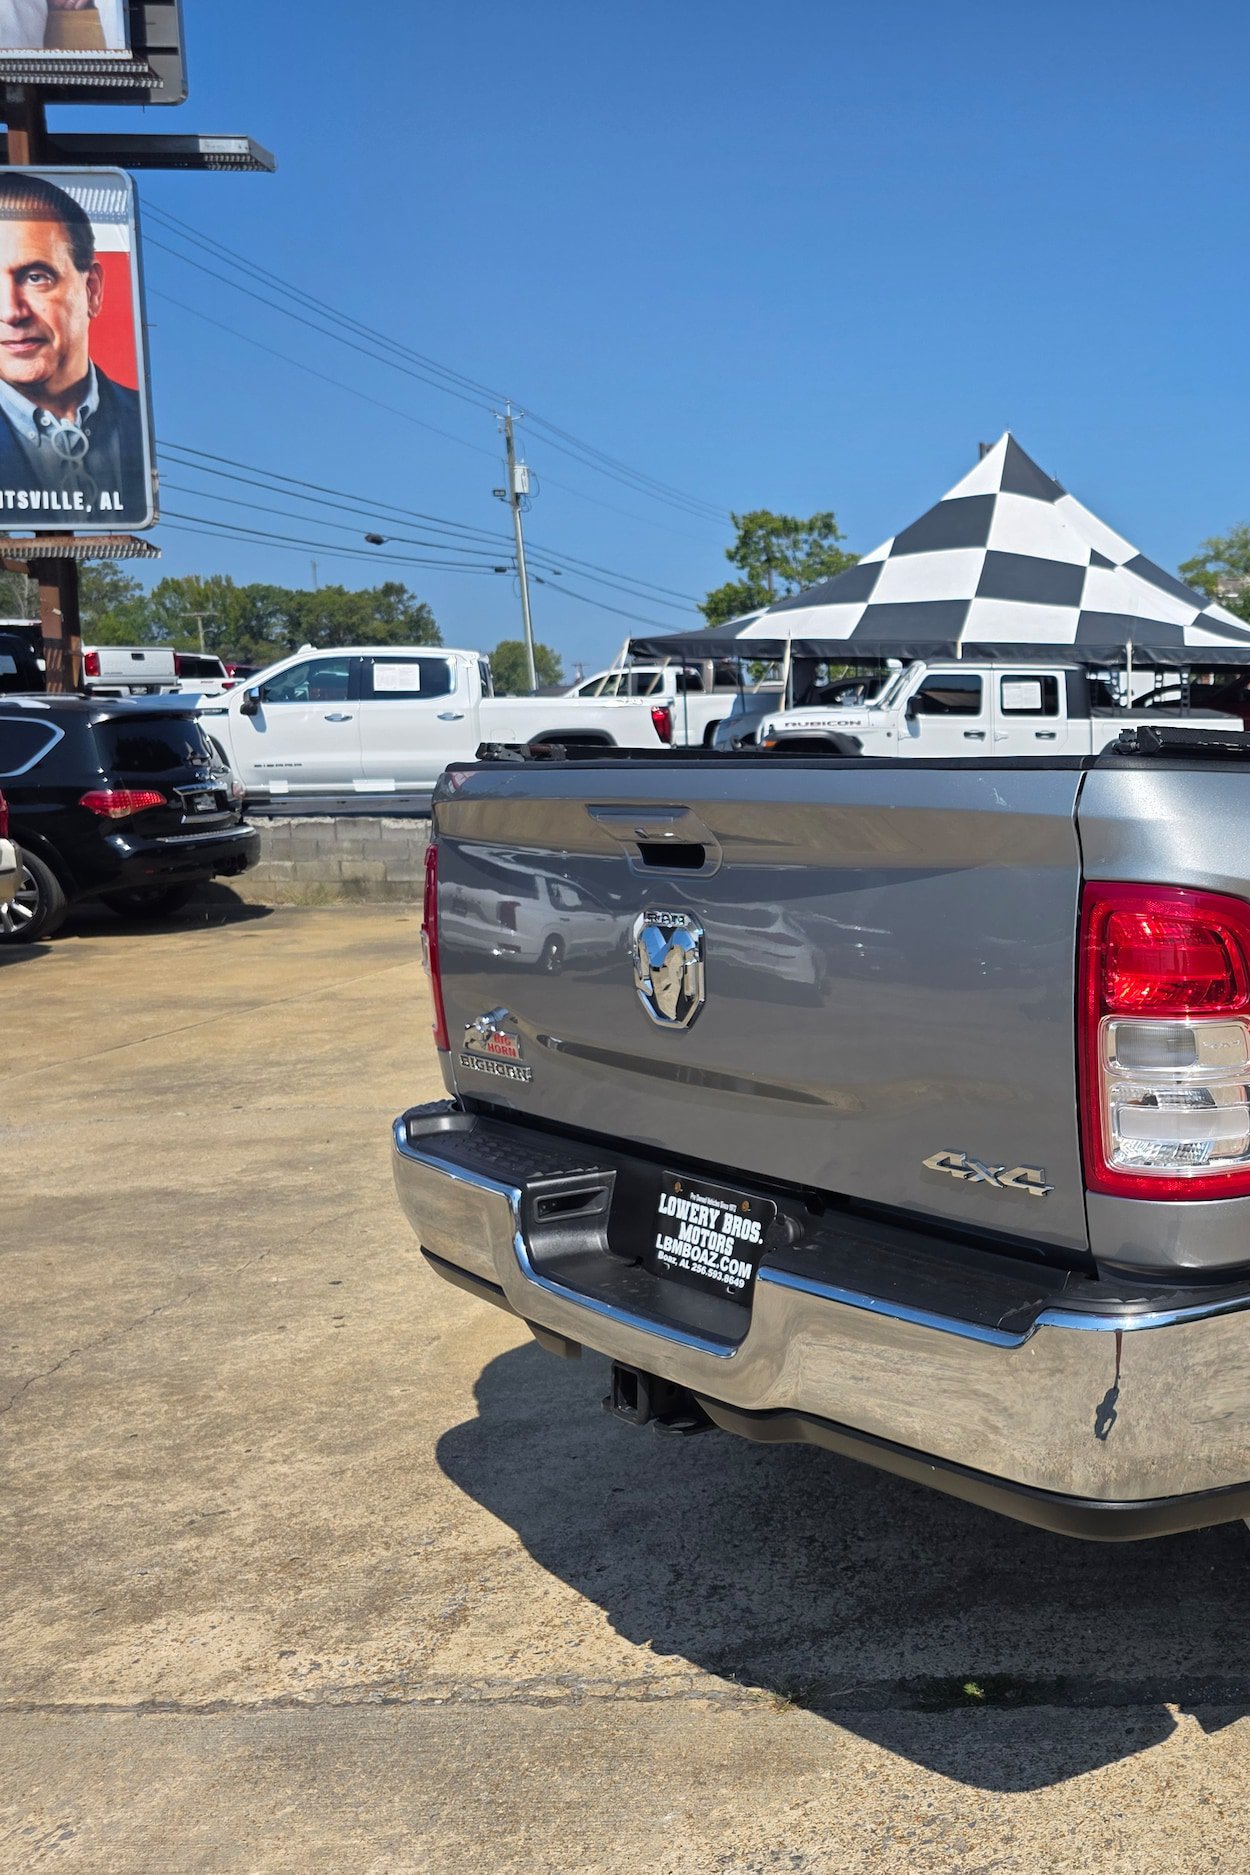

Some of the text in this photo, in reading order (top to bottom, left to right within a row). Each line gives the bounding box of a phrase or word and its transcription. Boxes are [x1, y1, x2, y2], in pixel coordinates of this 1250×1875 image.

[100, 491, 124, 511] AL
[784, 719, 862, 728] RUBICON
[487, 1043, 518, 1058] HORN
[459, 1053, 534, 1083] BIGHORN
[658, 1192, 764, 1245] LOWERY BROS.
[677, 1221, 735, 1257] MOTORS
[655, 1233, 753, 1280] LBMBOAZ.COM
[657, 1250, 679, 1267] Boaz,
[678, 1259, 691, 1270] AL
